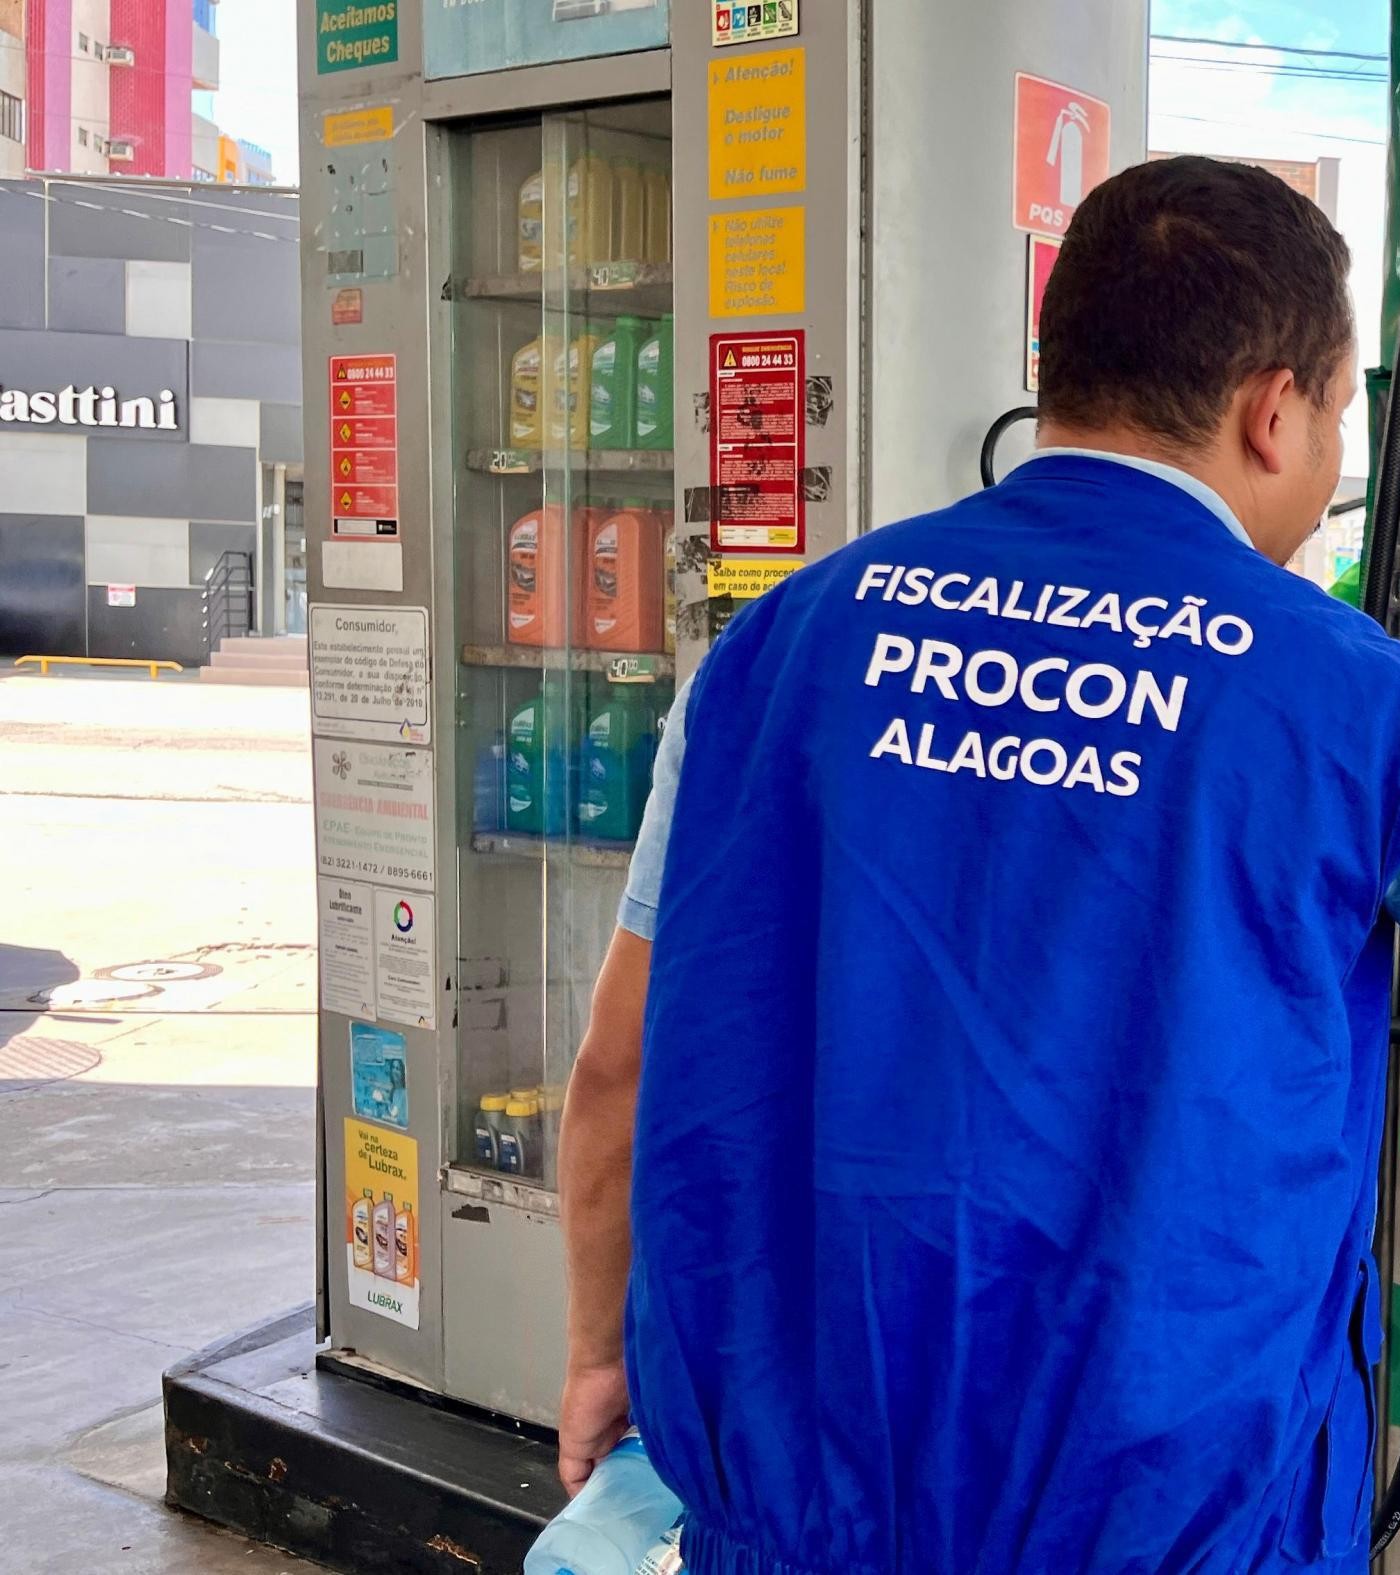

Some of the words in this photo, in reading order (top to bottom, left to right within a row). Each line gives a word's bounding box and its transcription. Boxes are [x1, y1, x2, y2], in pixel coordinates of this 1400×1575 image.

[320, 2, 395, 34] Aceitamos
[327, 35, 390, 64] Cheques
[724, 59, 794, 83] Atenção!
[725, 103, 791, 126] Desligue
[738, 125, 785, 146] motor
[724, 164, 754, 186] Não
[760, 163, 797, 182] fume
[1029, 203, 1064, 227] PQS
[761, 354, 771, 366] 24
[772, 354, 782, 366] 44
[783, 353, 794, 365] 33
[0, 384, 178, 430] asttini
[713, 566, 739, 578] Saiba
[740, 570, 762, 578] como
[763, 567, 795, 579] proced
[728, 583, 747, 591] caso
[748, 580, 760, 591] de
[854, 564, 1255, 656] FISCALIZAÇÃO
[335, 617, 398, 635] Consumidor,
[610, 659, 628, 677] 40
[863, 633, 1189, 732] PROCON
[869, 718, 1142, 797] ALAGOAS
[336, 858, 378, 874] 3221-1472
[358, 1130, 369, 1142] Vai
[370, 1134, 379, 1144] na
[358, 1149, 367, 1159] de
[364, 1142, 399, 1161] certeza
[367, 1290, 404, 1315] LUBRAX
